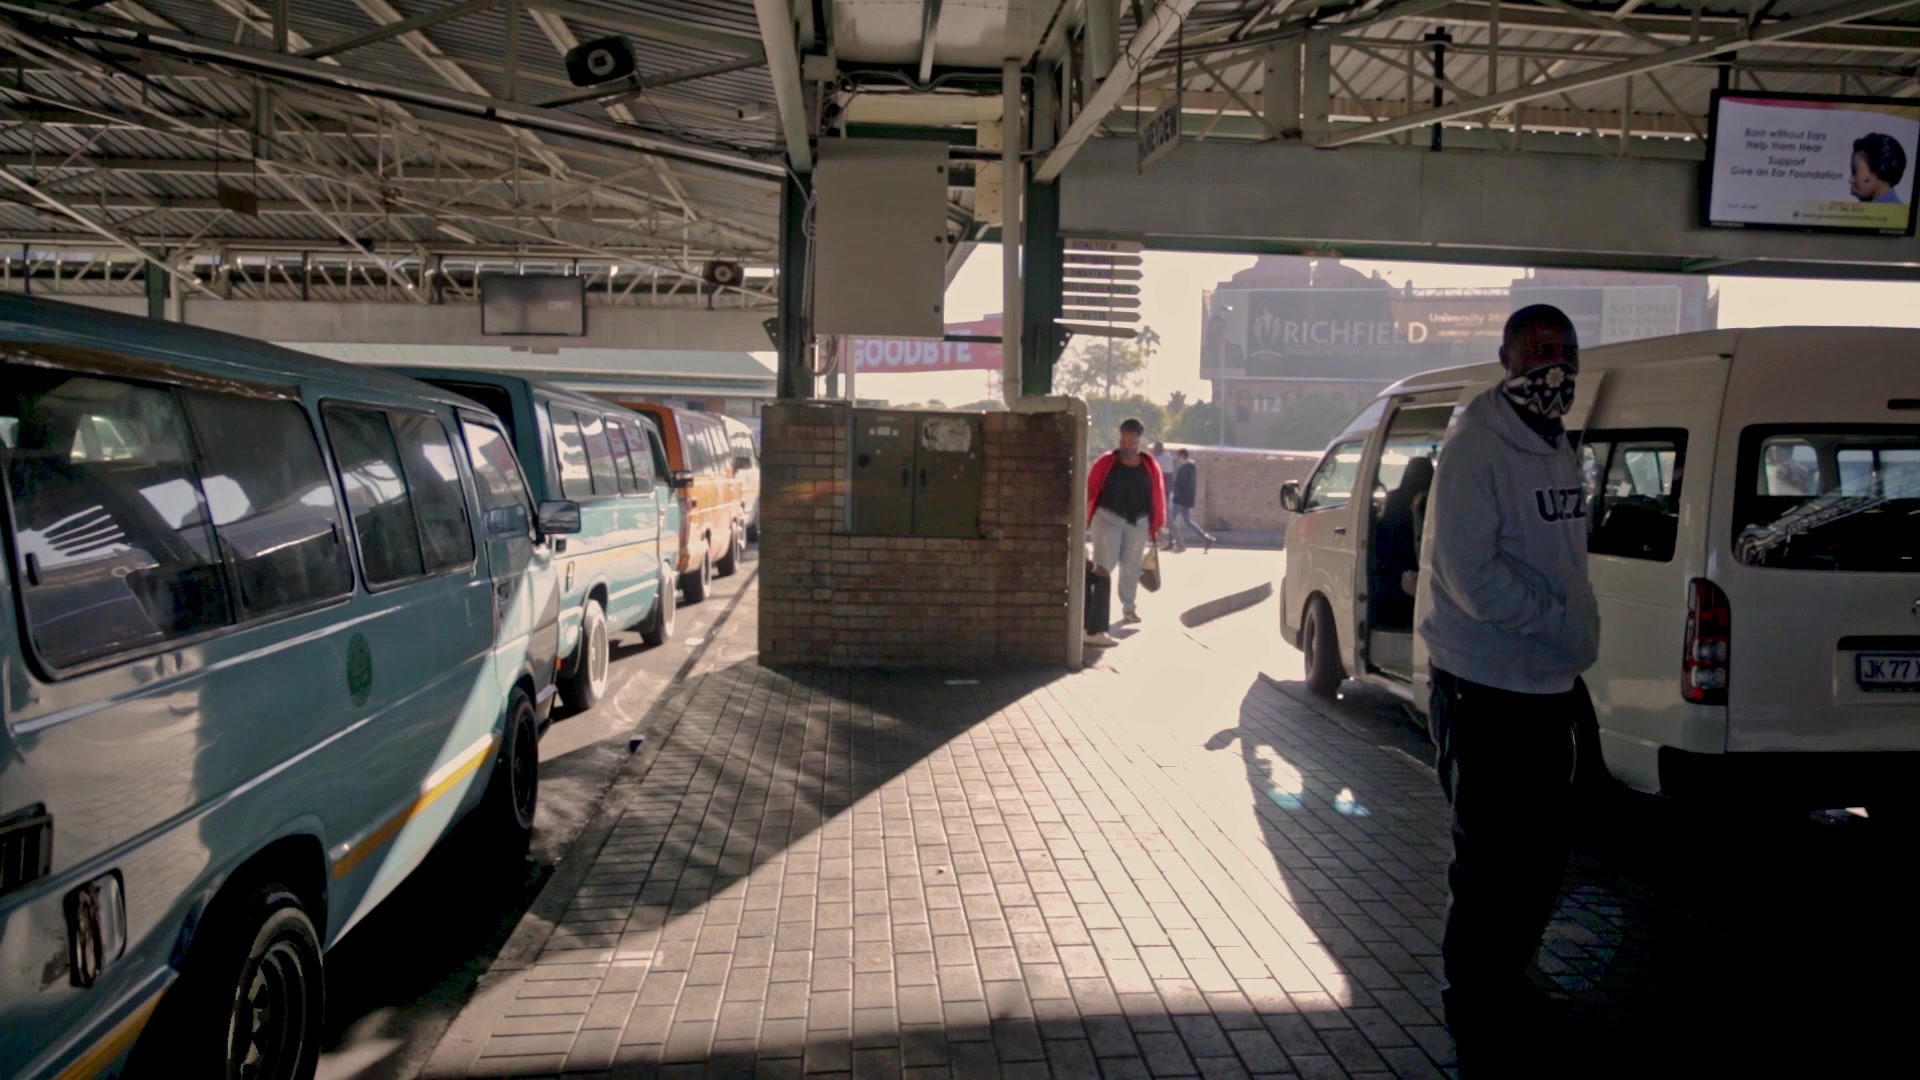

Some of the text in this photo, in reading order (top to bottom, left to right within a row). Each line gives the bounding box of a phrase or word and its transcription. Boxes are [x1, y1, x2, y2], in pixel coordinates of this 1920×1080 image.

[1744, 128, 1827, 141] Born without Ears
[1746, 141, 1823, 153] Help them Hear
[1768, 156, 1806, 167] Support
[1730, 166, 1844, 180] Give an Ear Foundation
[1610, 304, 1676, 314] NATIONAL
[1429, 312, 1485, 324] University
[1284, 320, 1429, 345] RICHFIELD
[1252, 395, 1281, 413] 112
[1864, 659, 1885, 679] JK
[1889, 660, 1911, 679] 77
